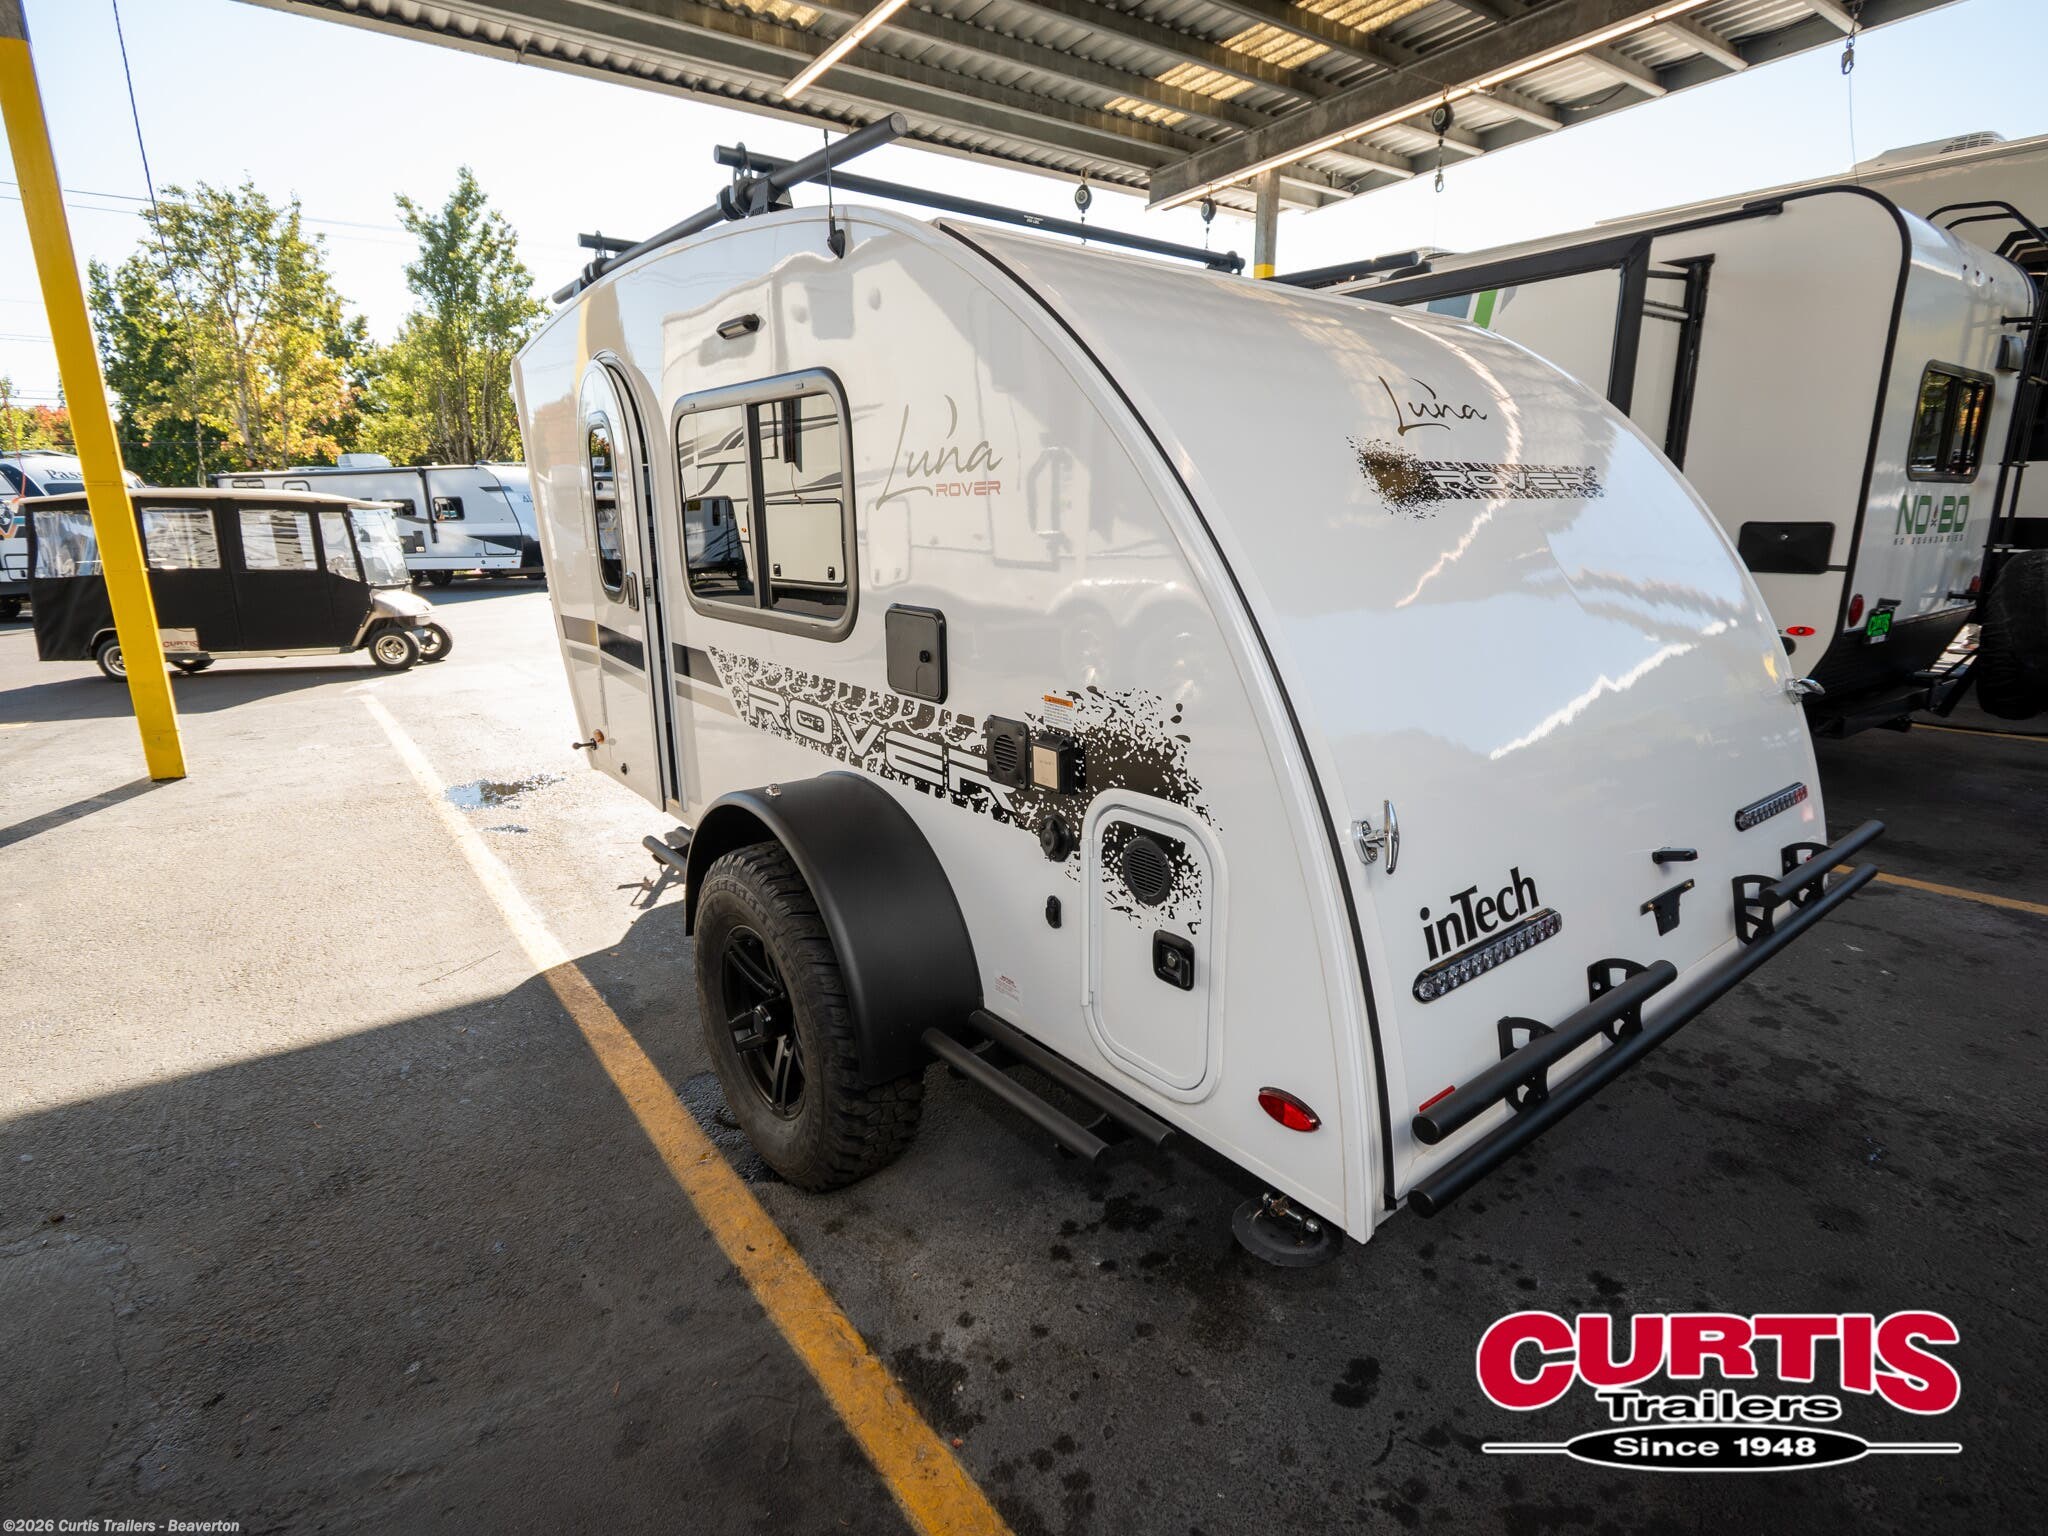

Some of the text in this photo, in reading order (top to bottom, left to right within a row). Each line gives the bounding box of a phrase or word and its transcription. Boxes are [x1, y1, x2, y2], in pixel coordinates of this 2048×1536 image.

[1378, 375, 1487, 436] Luna
[876, 394, 1003, 511] Luna
[935, 480, 1001, 497] ROVER
[1432, 470, 1586, 490] ROVER
[747, 686, 1016, 812] ROVER
[1420, 866, 1540, 962] inTech
